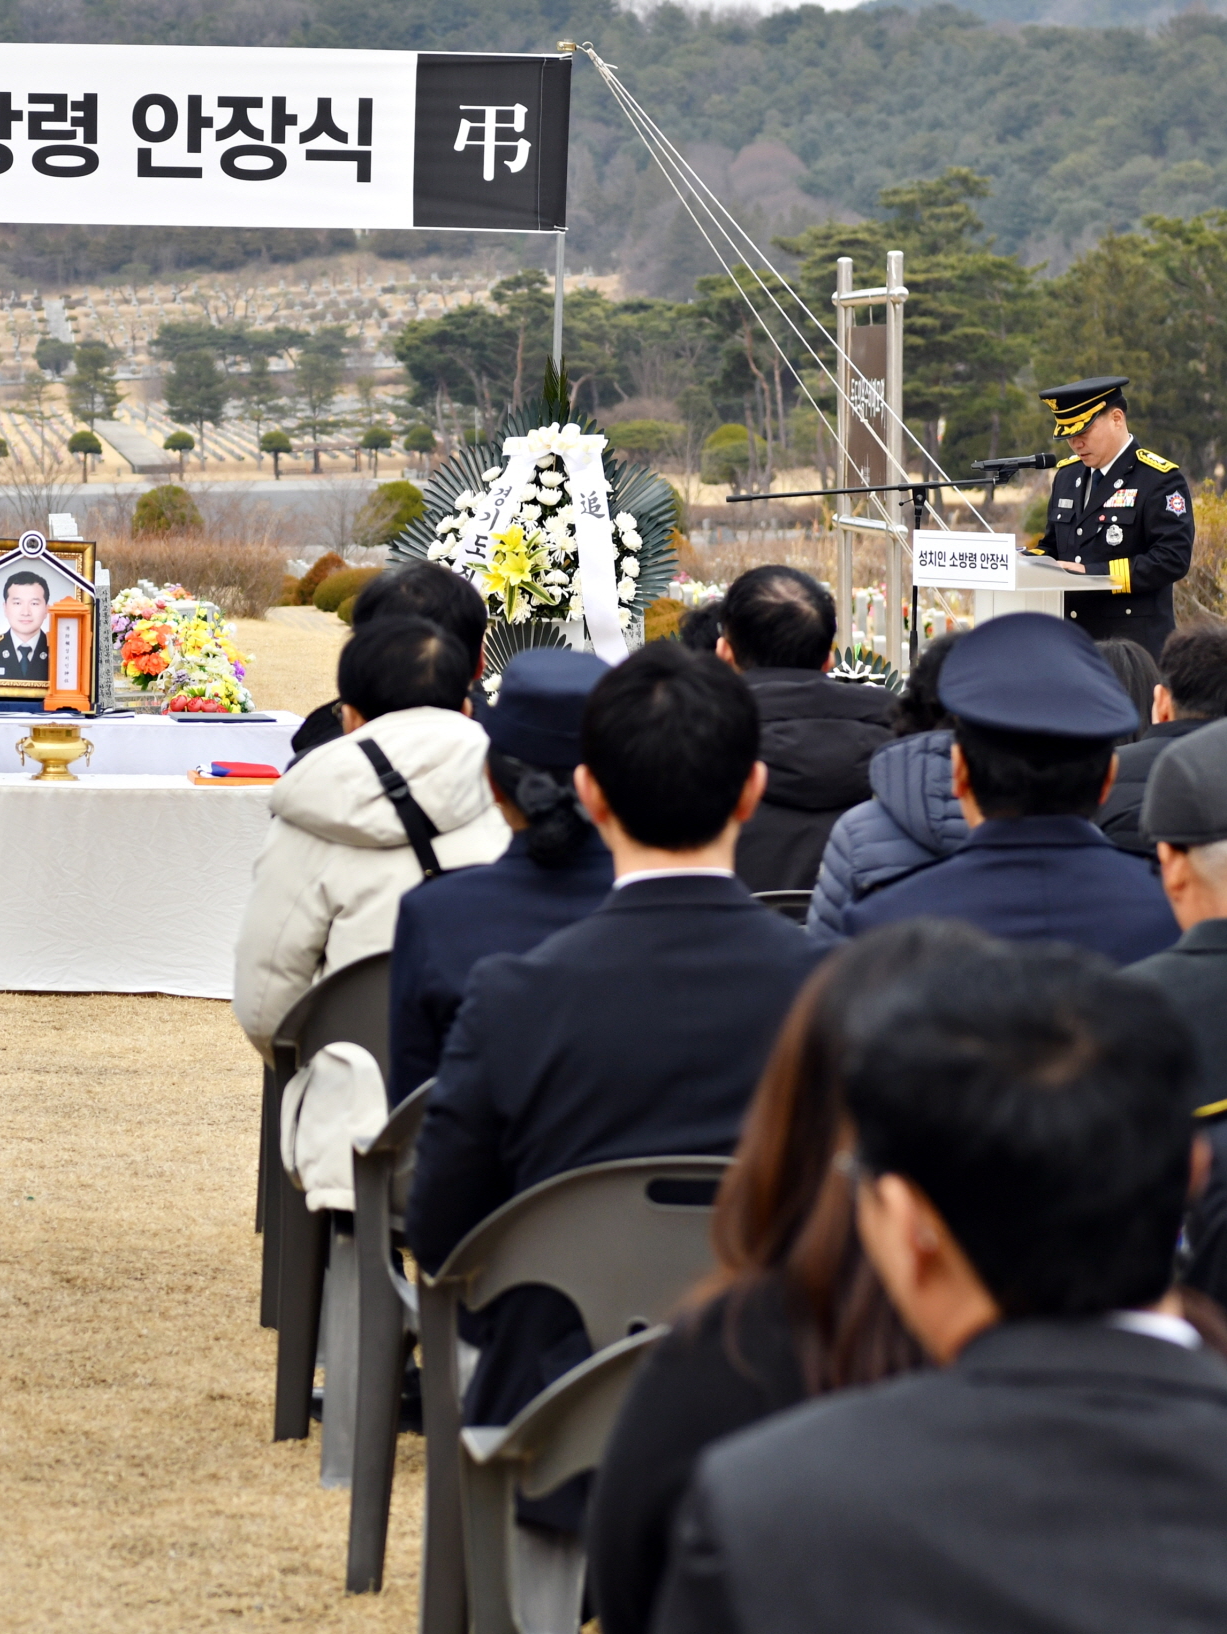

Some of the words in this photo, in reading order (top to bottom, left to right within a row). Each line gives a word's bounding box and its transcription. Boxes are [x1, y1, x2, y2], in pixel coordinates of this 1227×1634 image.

[132, 93, 374, 183] 안장식
[580, 490, 606, 519] 追
[919, 550, 946, 567] 성치인
[949, 551, 977, 569] 소방령
[980, 552, 1009, 570] 안장식
